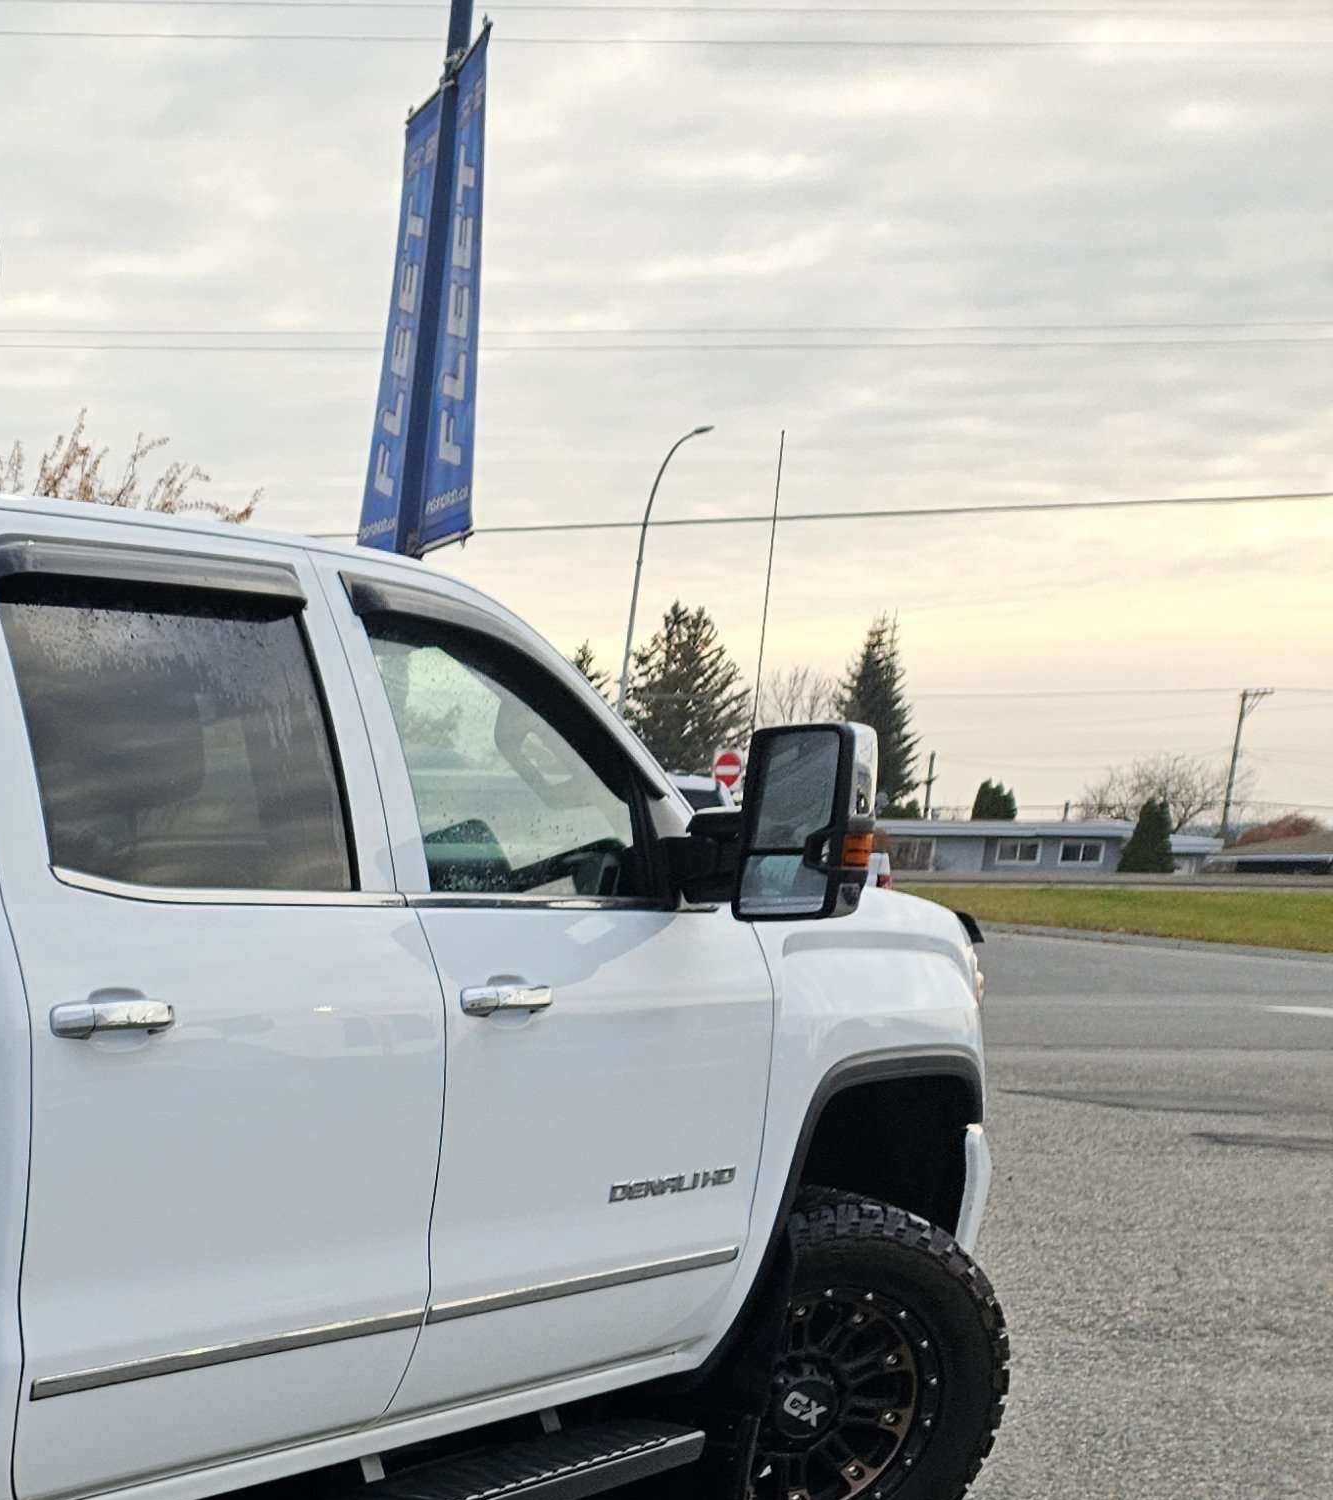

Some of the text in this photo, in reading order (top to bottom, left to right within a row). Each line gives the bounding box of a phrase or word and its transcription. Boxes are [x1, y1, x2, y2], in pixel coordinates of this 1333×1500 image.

[374, 194, 424, 497] FLEET
[438, 143, 475, 467] FLEET
[608, 1164, 737, 1204] DENALI HD
